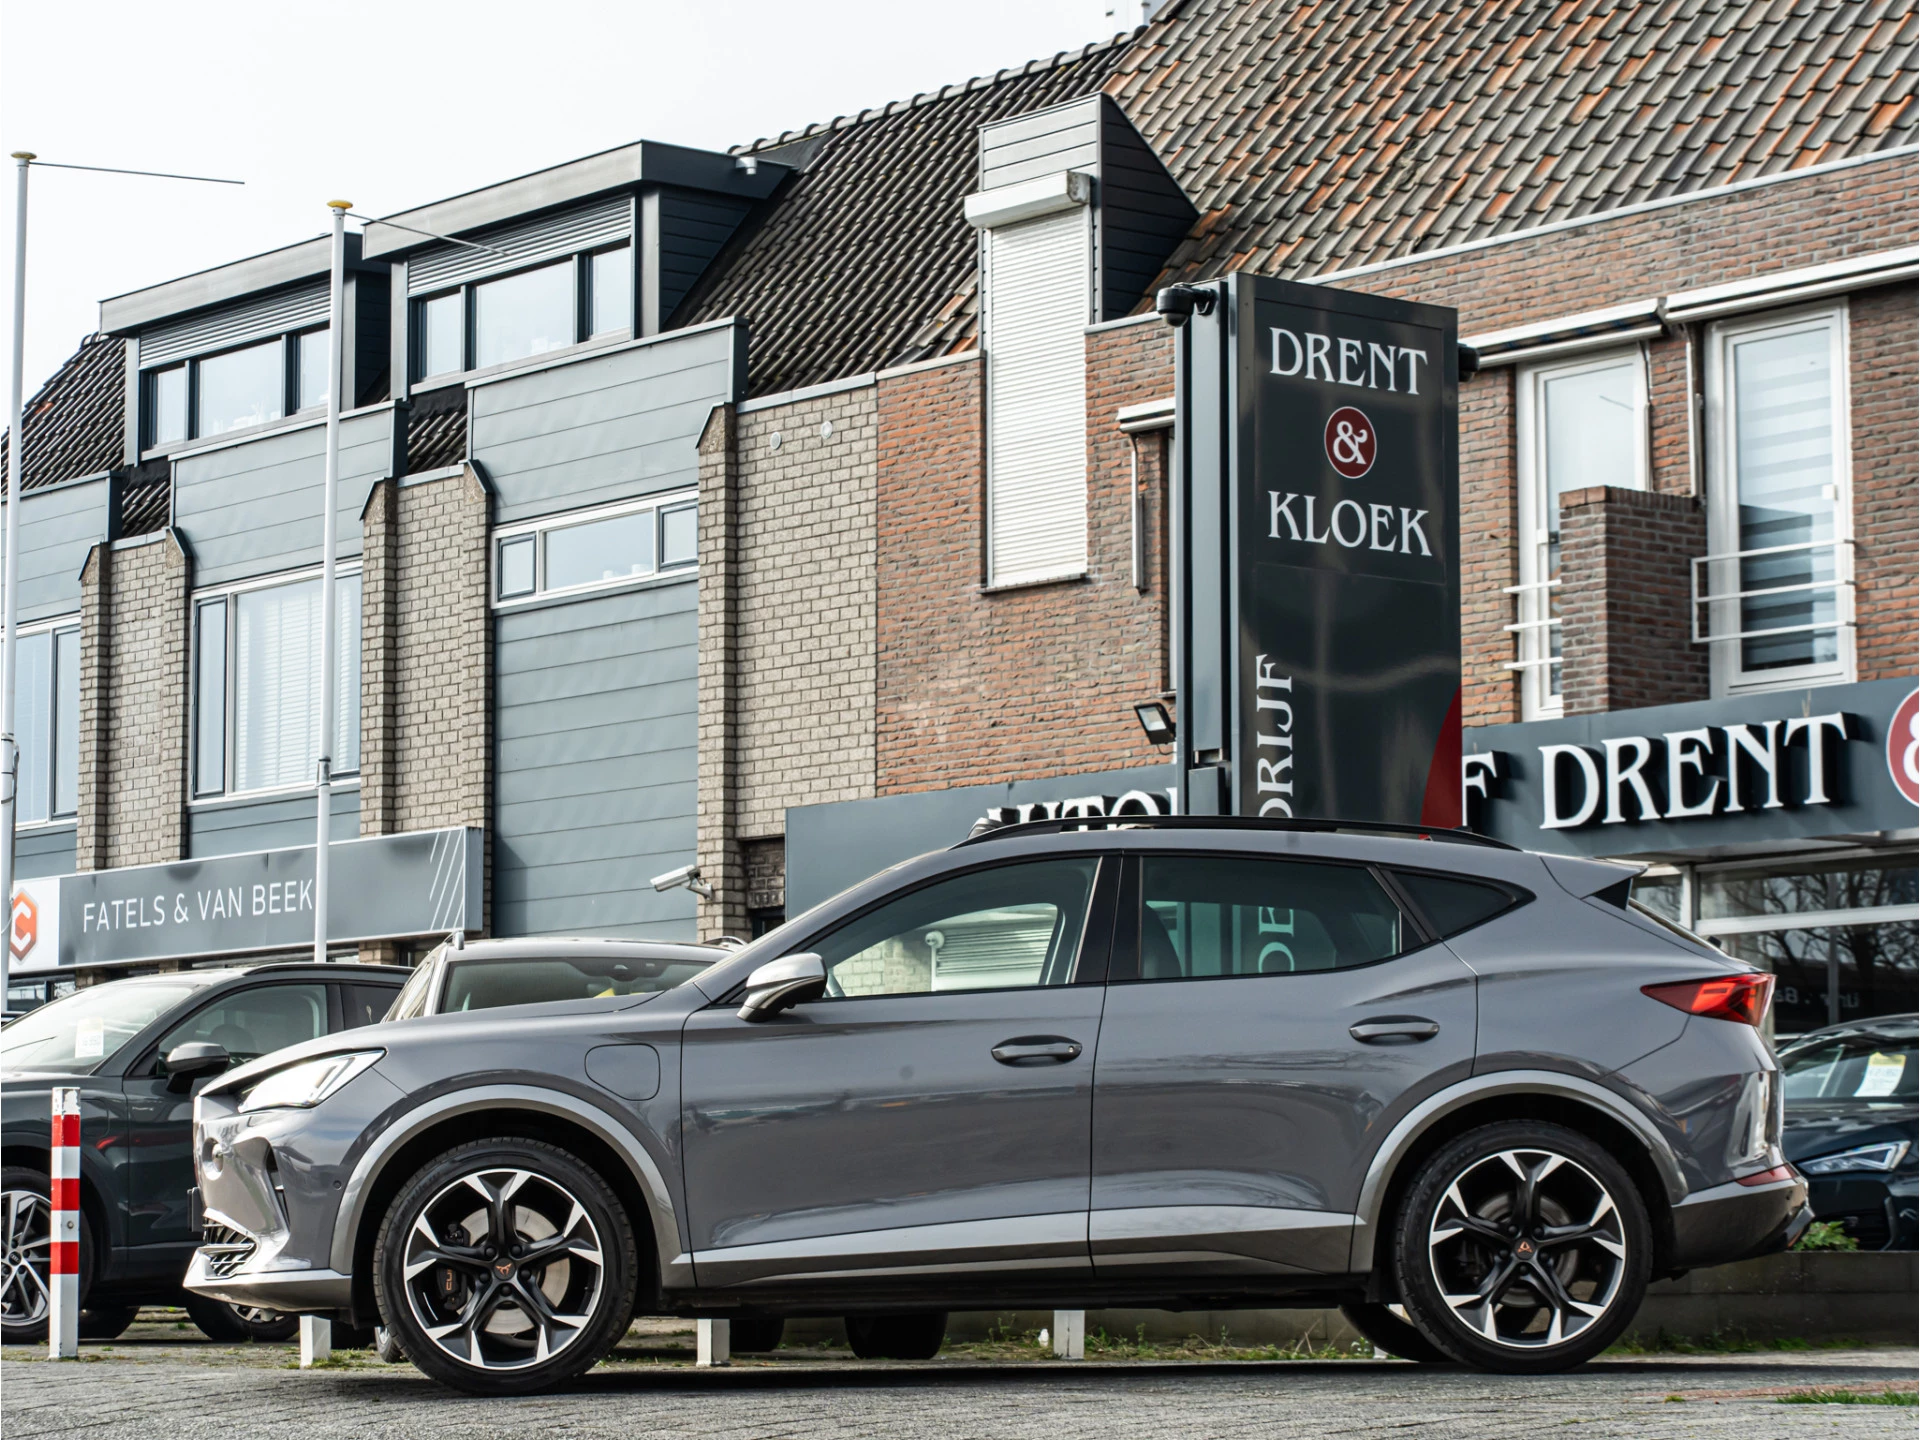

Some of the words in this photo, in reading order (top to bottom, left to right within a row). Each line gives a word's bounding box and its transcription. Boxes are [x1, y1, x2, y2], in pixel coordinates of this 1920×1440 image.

[1269, 326, 1428, 395] DRENT
[1333, 421, 1368, 465] &
[1267, 490, 1432, 556] KLOEK
[1538, 711, 1847, 829] DRENT
[83, 894, 166, 933] FATELS
[174, 892, 189, 924] &
[197, 886, 242, 921] VAN
[252, 878, 313, 917] BEEK
